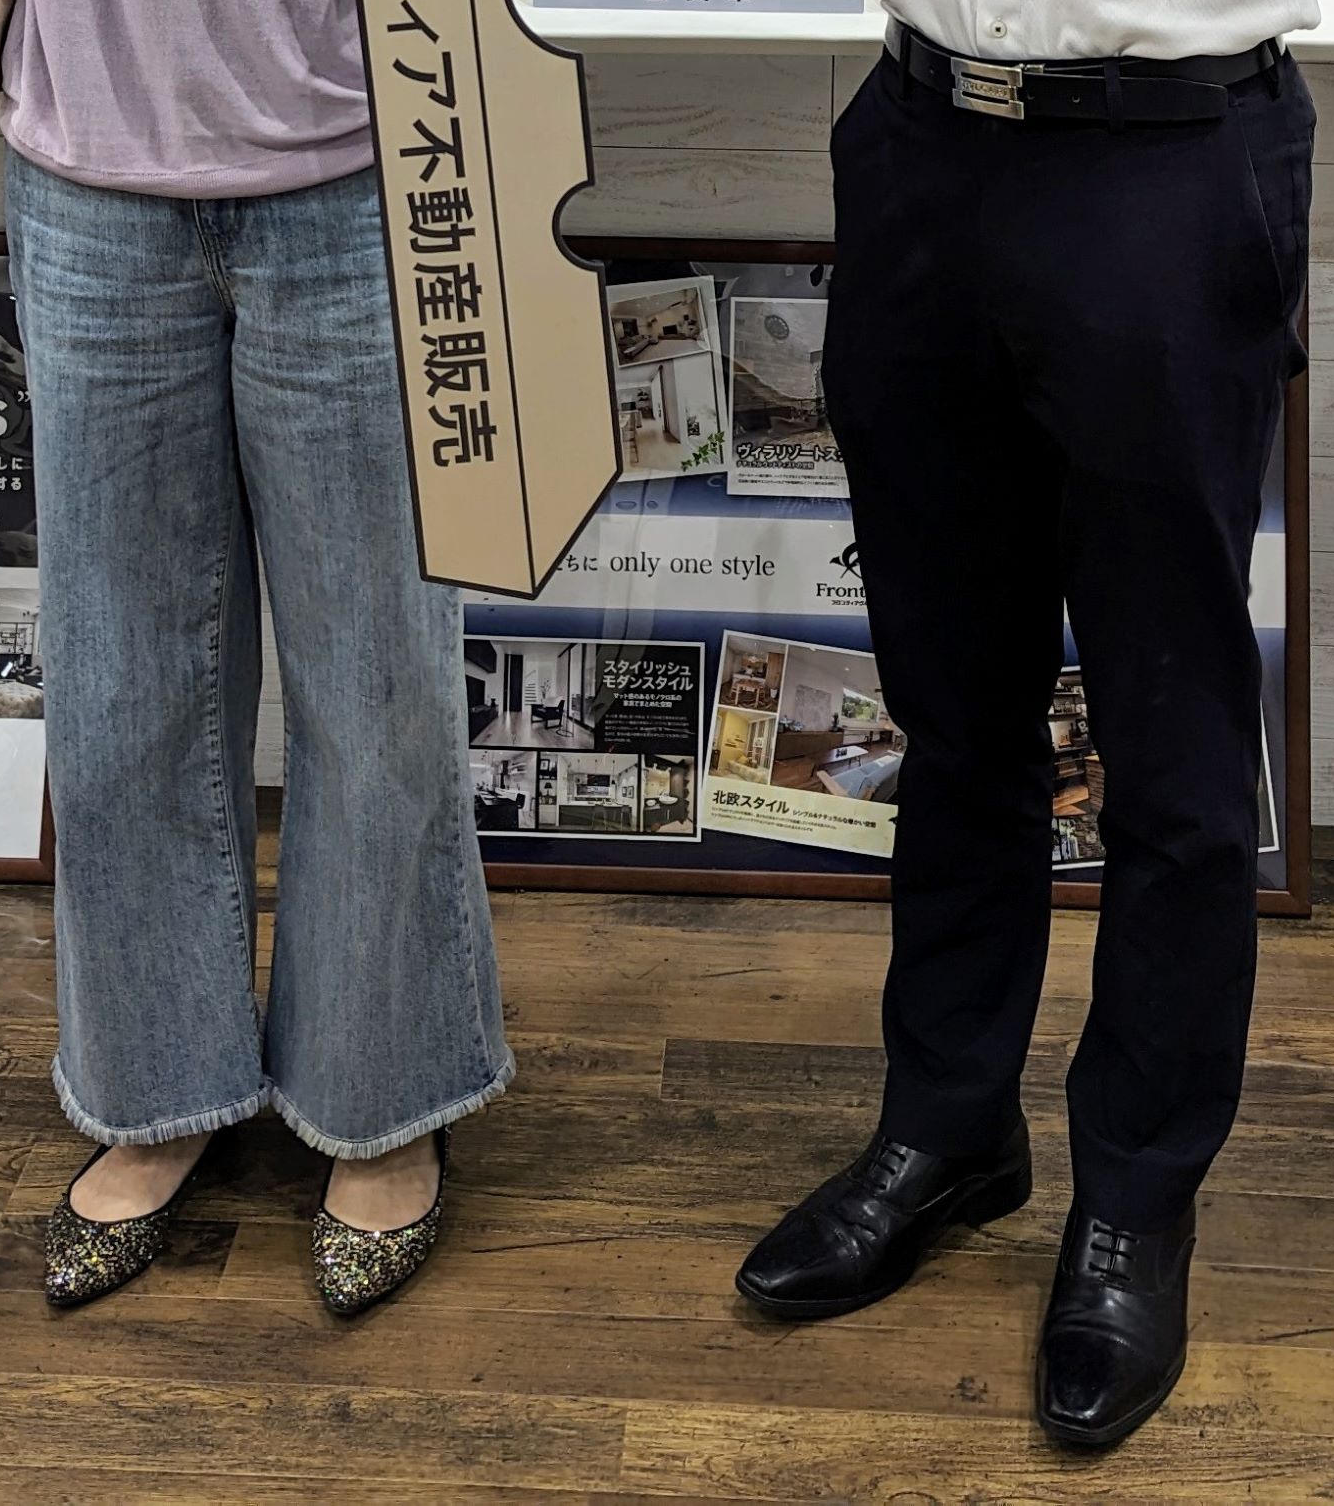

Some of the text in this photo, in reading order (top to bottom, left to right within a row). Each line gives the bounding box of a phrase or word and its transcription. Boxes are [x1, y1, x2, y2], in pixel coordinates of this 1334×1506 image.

[737, 445, 844, 461] ヴィラリゾートス
[610, 552, 660, 577] only
[670, 557, 713, 574] one
[721, 556, 775, 580] style
[604, 660, 691, 675] スタイリッシュ
[603, 675, 693, 691] モダンスタイル
[713, 791, 789, 815] 北欧スタイル
